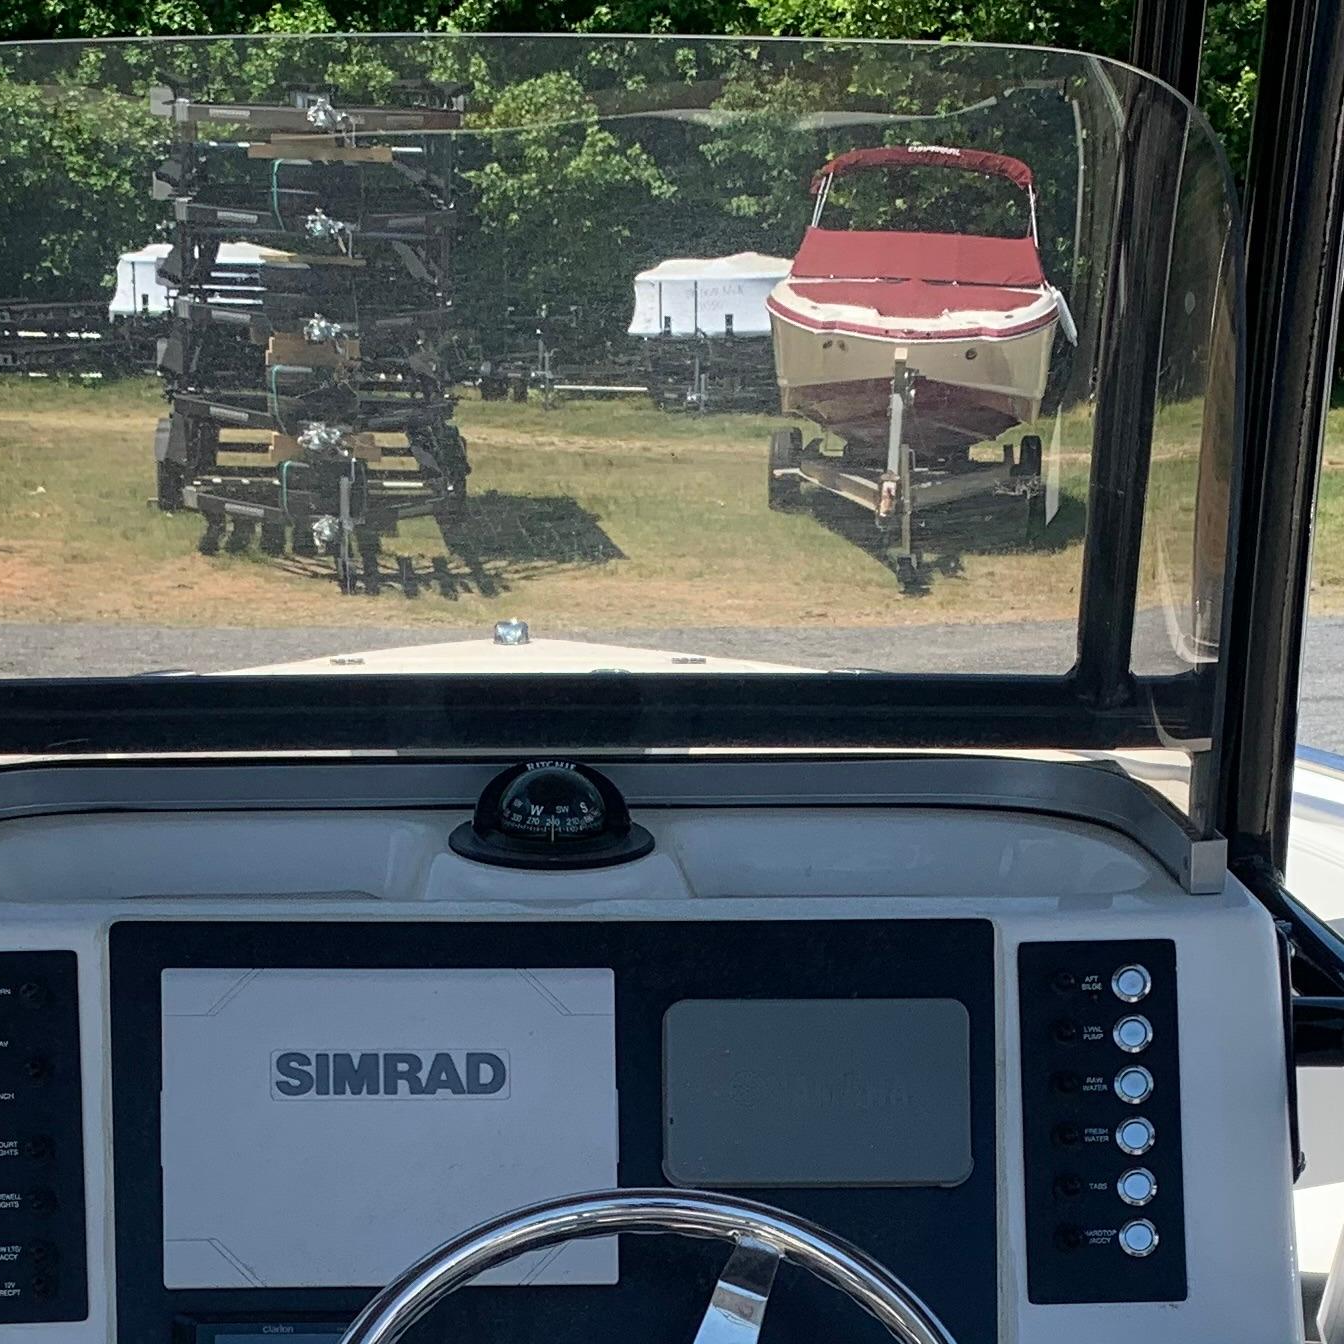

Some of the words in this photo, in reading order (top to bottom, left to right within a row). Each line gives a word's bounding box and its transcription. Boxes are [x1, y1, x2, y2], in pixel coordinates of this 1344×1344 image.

[526, 761, 576, 771] RITCHIE
[531, 805, 544, 815] W
[580, 802, 588, 813] S
[526, 816, 540, 825] 270
[275, 1051, 507, 1097] SIMRAD
[263, 1325, 294, 1333] clarion
